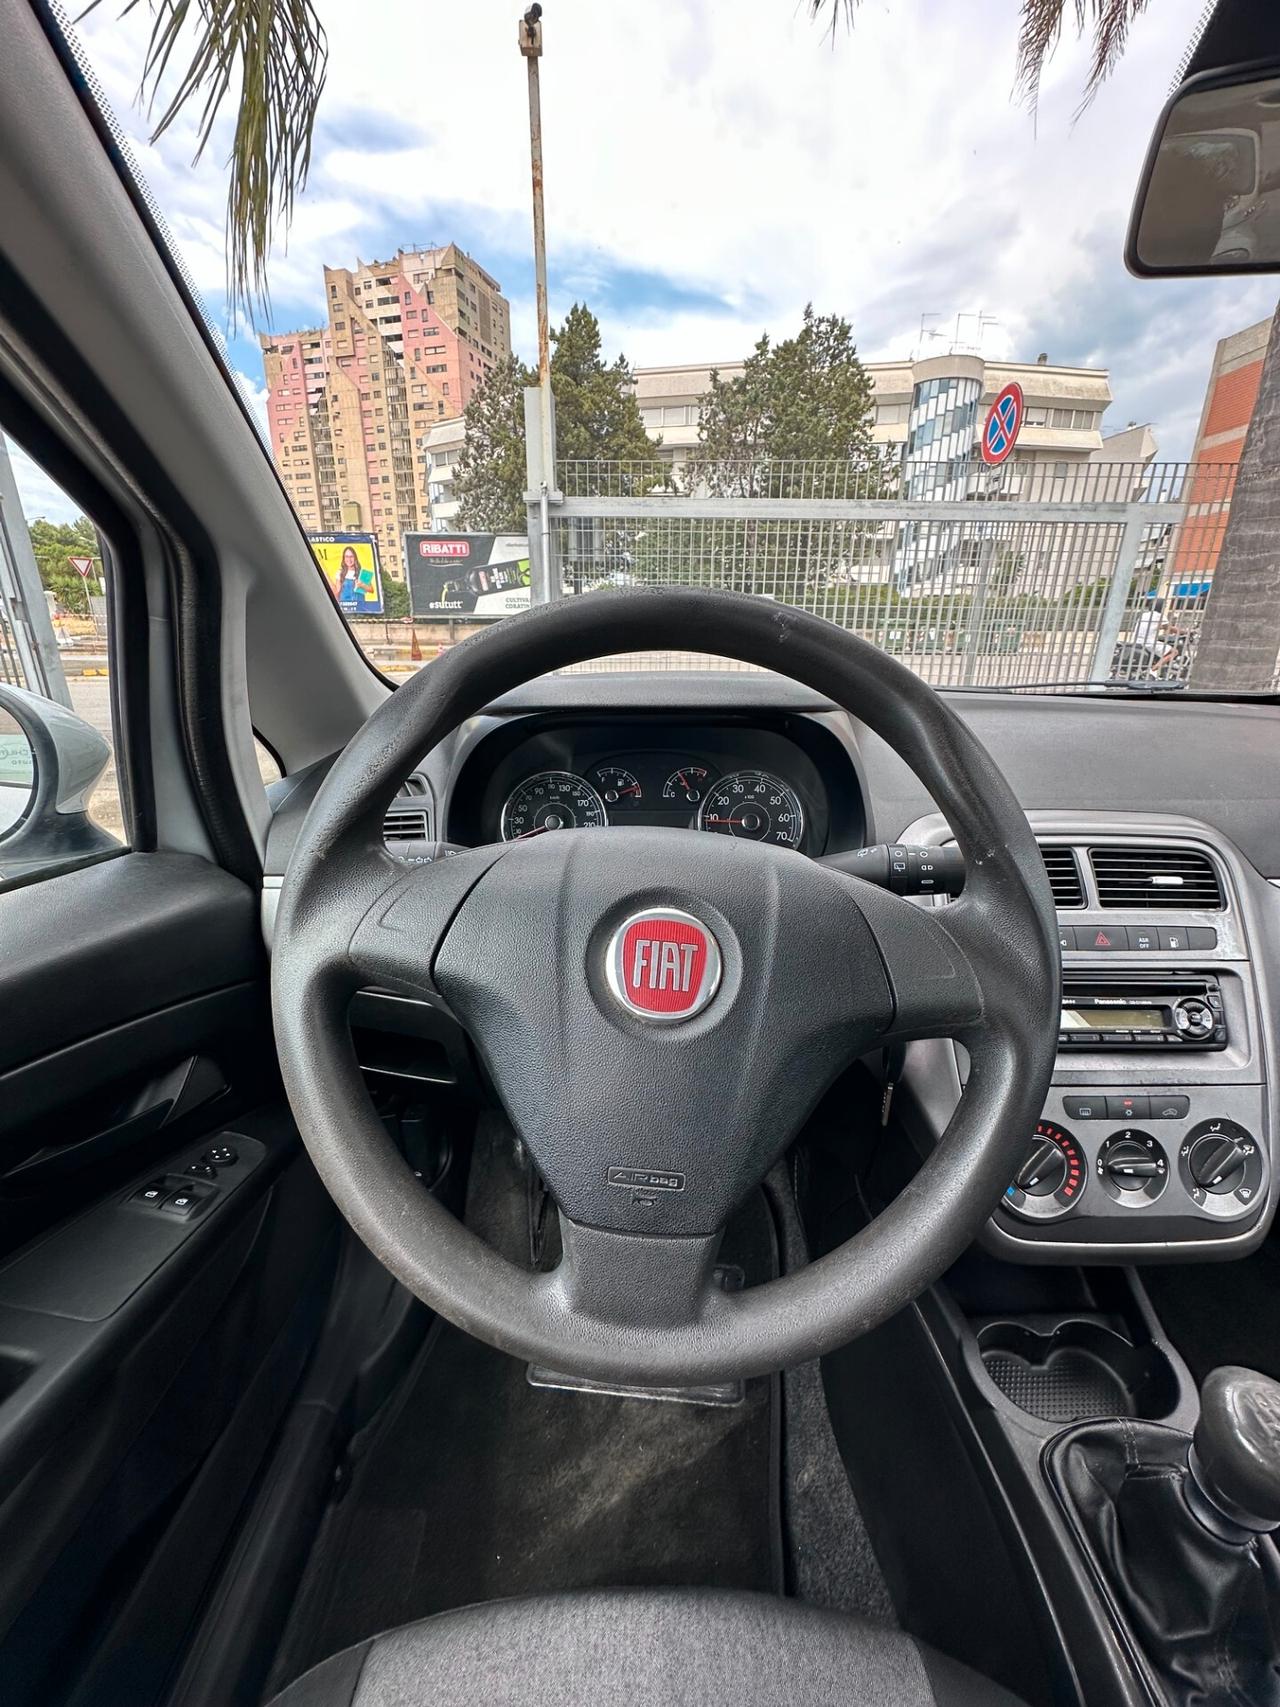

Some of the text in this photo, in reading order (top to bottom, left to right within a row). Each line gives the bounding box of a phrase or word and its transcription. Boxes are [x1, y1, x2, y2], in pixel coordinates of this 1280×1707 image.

[422, 543, 467, 554] RIBATTI
[534, 787, 544, 795] 90
[732, 785, 744, 793] 30
[753, 785, 766, 793] 40
[577, 799, 589, 807] 170
[717, 796, 730, 805] 20
[769, 796, 782, 805] 50
[709, 813, 719, 821] 10
[778, 814, 790, 822] 60
[776, 831, 788, 840] 70
[632, 939, 699, 992] FIAT
